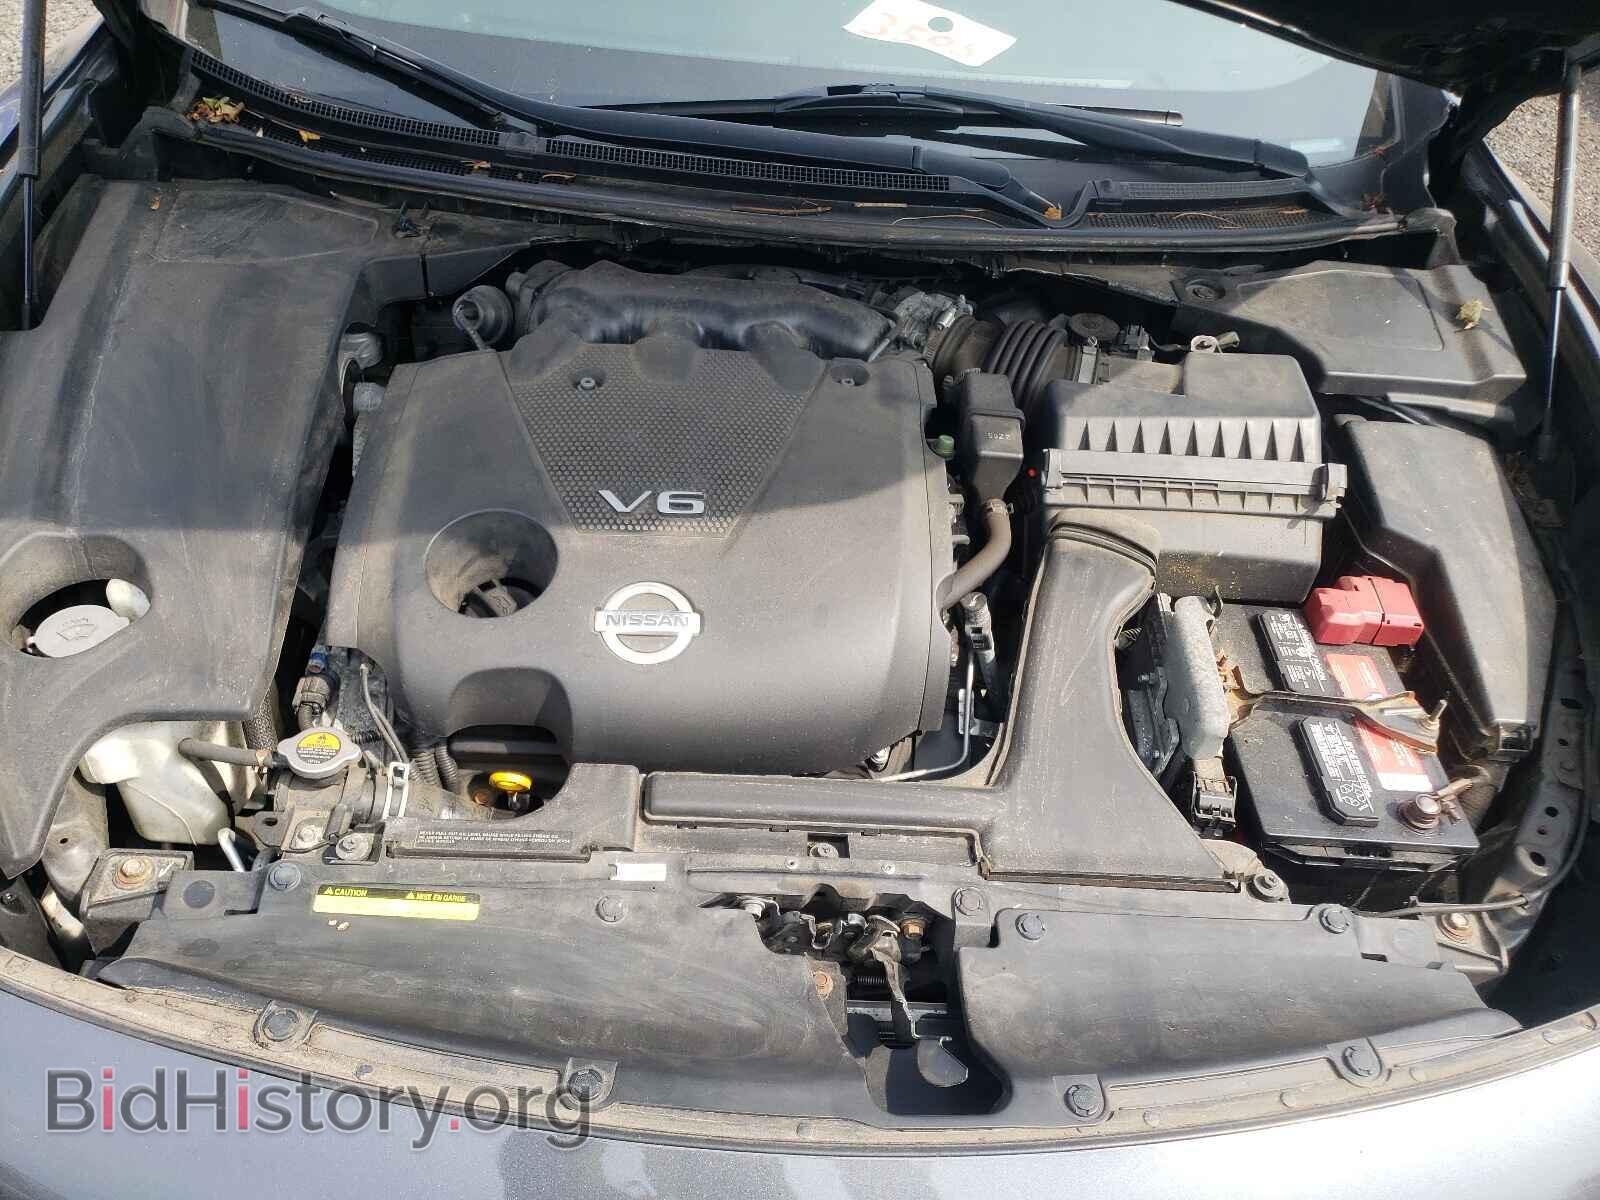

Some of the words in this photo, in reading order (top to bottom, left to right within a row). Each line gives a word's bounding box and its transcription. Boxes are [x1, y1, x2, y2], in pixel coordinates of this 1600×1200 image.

[598, 489, 705, 514] V6
[605, 614, 689, 627] NISSAN
[335, 888, 368, 897] CAUTION
